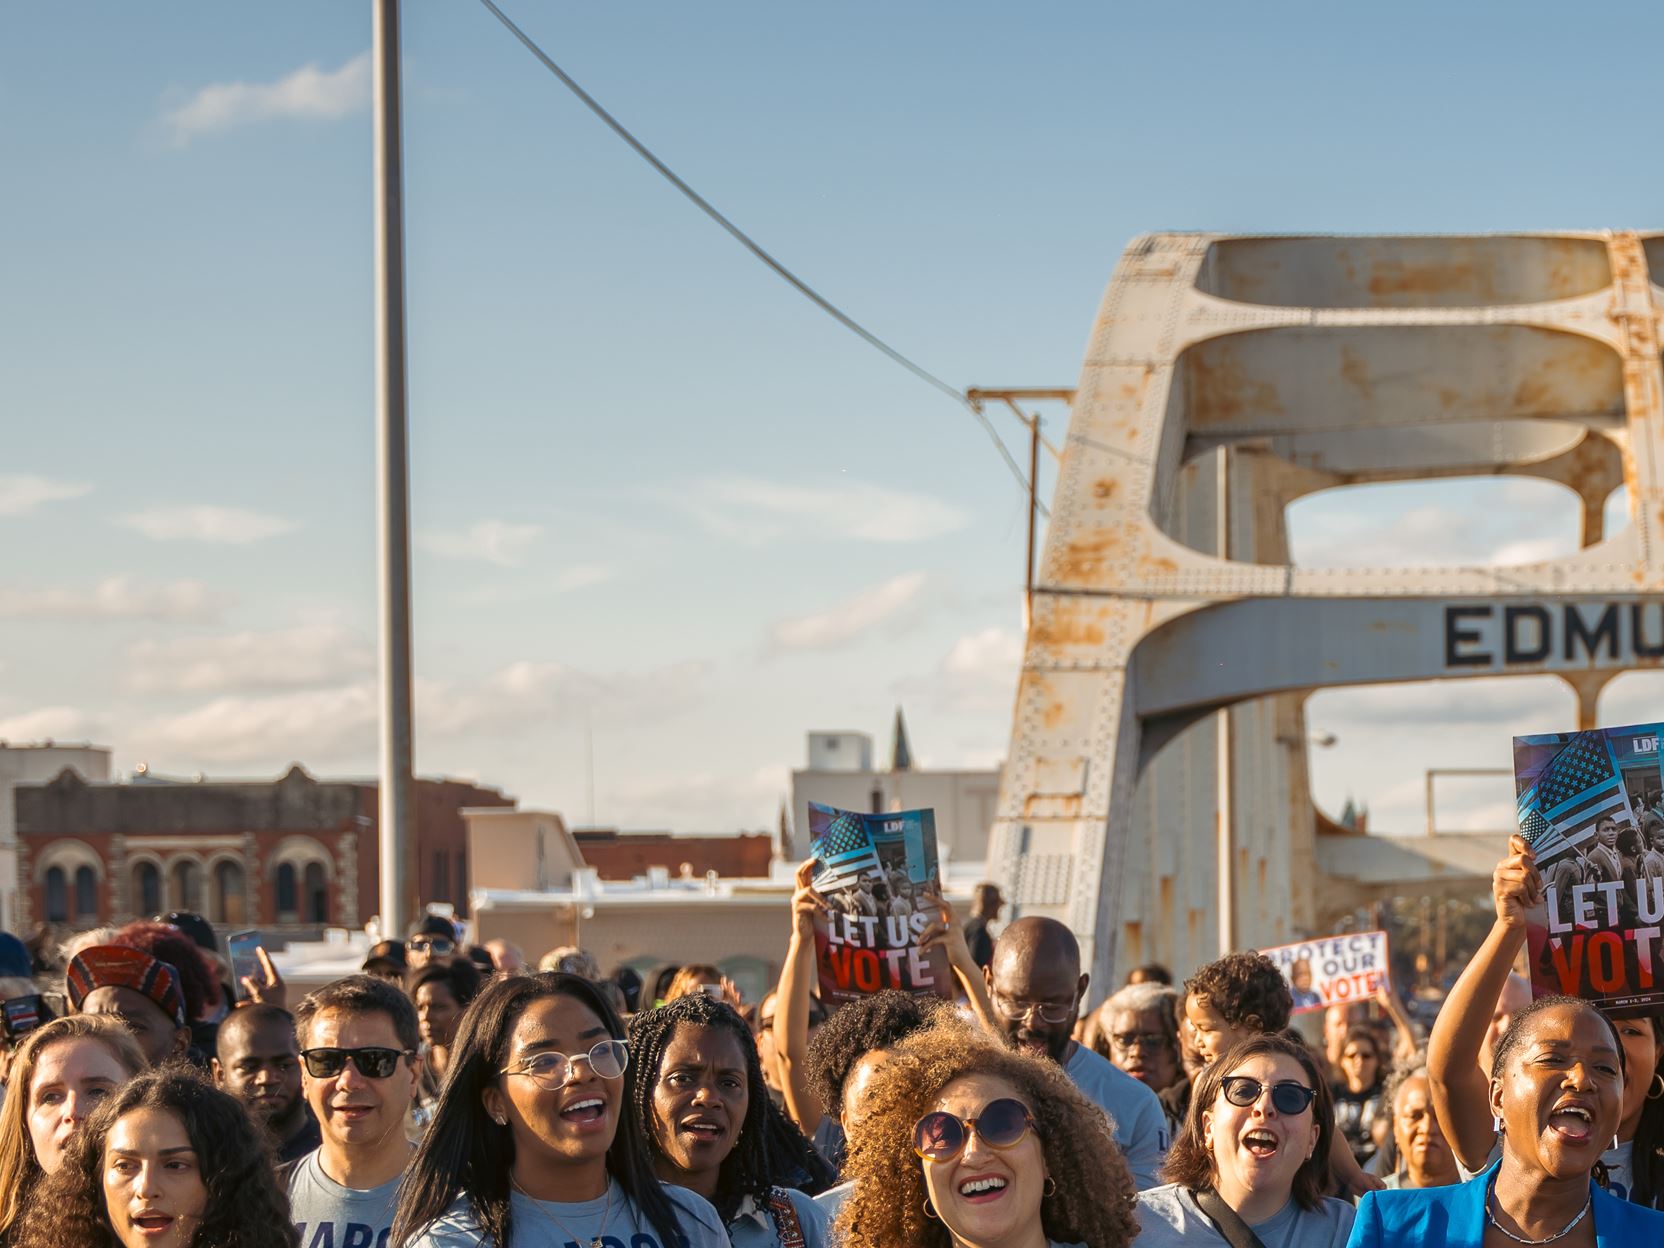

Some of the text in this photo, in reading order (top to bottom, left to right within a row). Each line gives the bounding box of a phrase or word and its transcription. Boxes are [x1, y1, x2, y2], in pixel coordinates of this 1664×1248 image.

[1633, 738, 1659, 753] LDF
[884, 821, 905, 833] LDF
[1547, 881, 1625, 934] LET
[828, 911, 929, 948] LET US
[829, 945, 935, 994] VOTE
[1323, 953, 1375, 976] OUR
